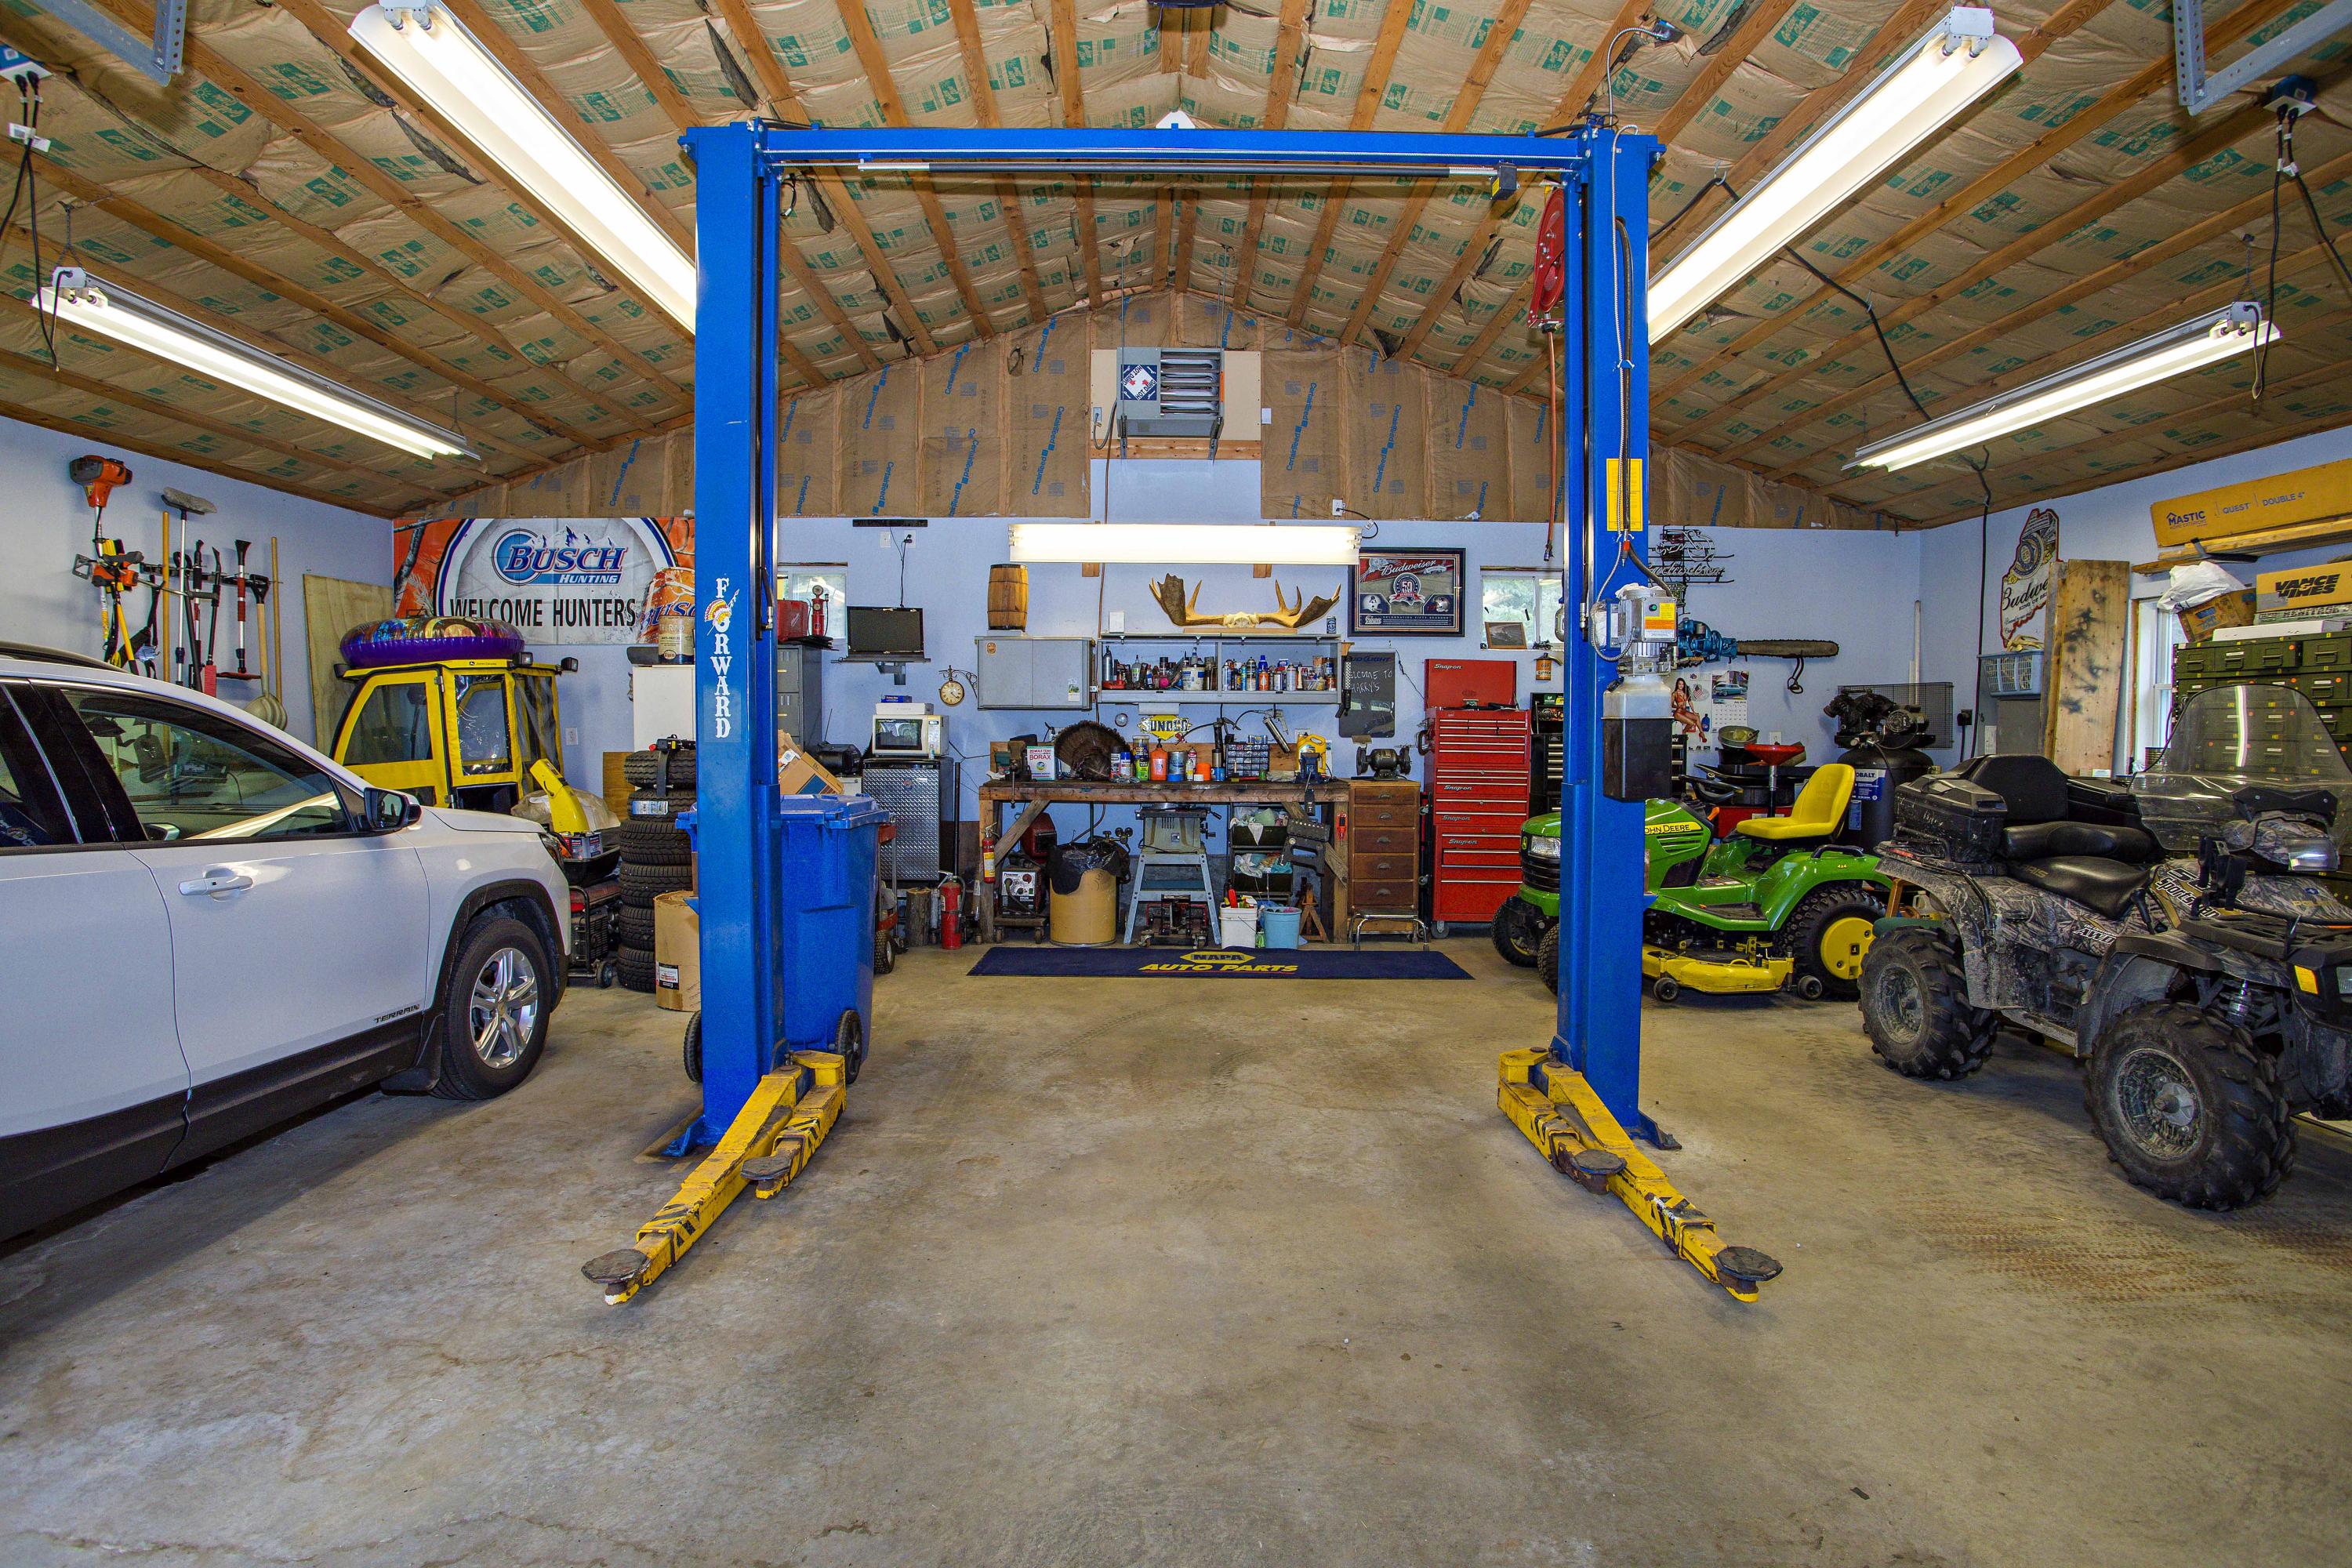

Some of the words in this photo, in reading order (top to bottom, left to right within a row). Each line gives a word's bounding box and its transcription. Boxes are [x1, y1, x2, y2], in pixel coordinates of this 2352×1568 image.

[1134, 390, 1143, 400] HOT
[1144, 379, 1156, 392] DAWG
[2223, 503, 2249, 514] QUEST
[2263, 493, 2296, 507] DOUBLE
[2169, 511, 2206, 526] MASTIC
[503, 546, 628, 572] BUSCH
[1380, 559, 1436, 576] Budweiser
[558, 574, 618, 584] HUNTING
[2275, 574, 2341, 591] VANCE
[2002, 578, 2048, 611] Budwe
[553, 598, 636, 626] HUNTERS
[710, 578, 733, 739] FORWARD
[1383, 669, 1393, 679] TO
[1140, 717, 1189, 732] SUNOCO
[2072, 928, 2117, 946] AWD
[374, 1004, 420, 1024] TERRAIN
